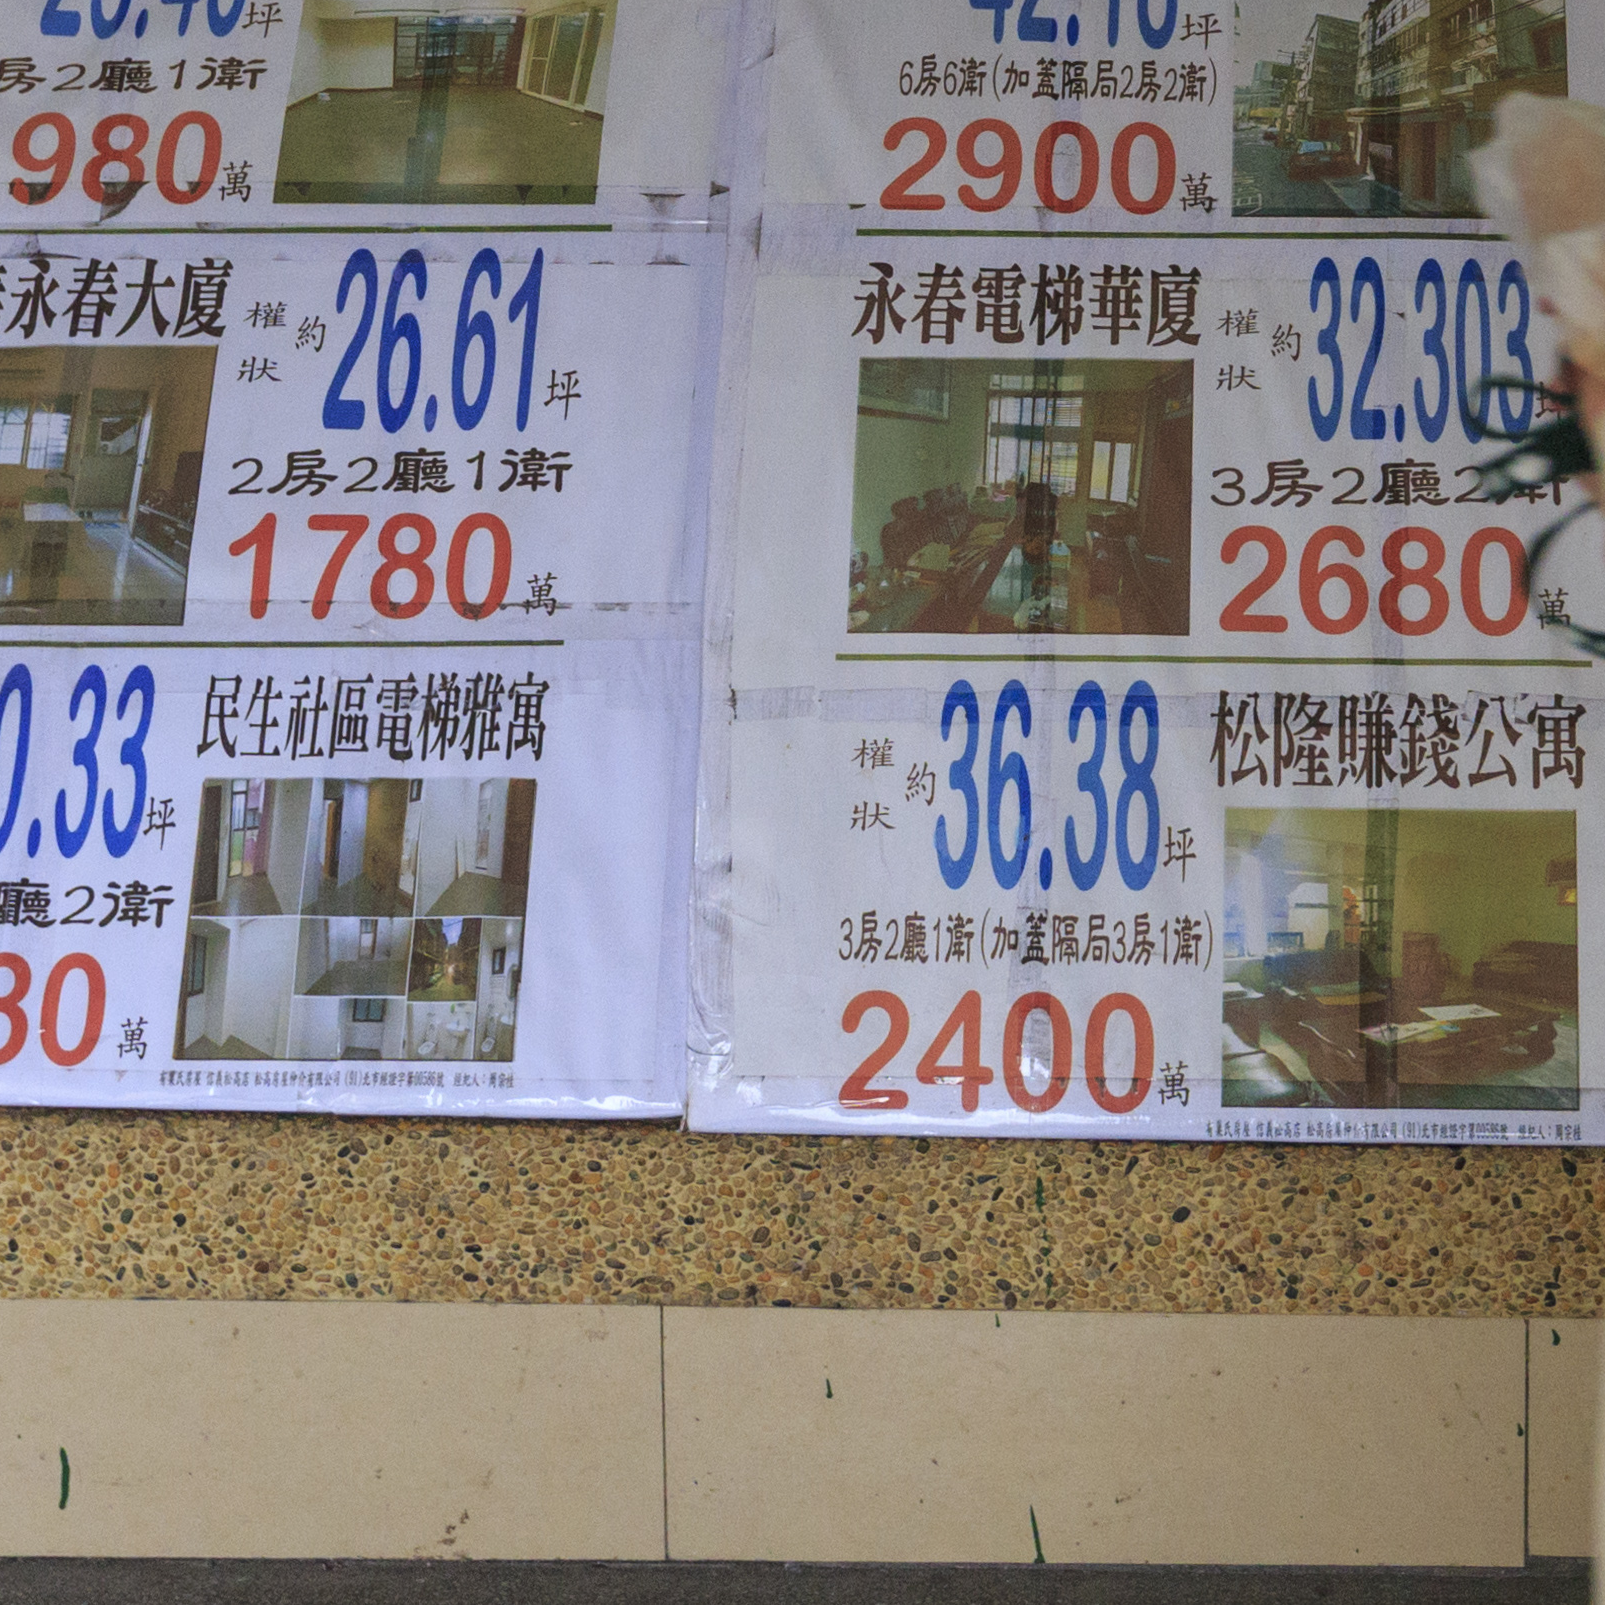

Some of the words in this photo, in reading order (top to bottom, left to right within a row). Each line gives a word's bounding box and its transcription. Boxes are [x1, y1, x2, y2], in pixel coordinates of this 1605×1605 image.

[244, 1, 283, 38] 坪
[1181, 13, 1223, 51] 坪
[217, 161, 253, 202] 萬
[879, 116, 1176, 216] 2900
[1179, 173, 1218, 214] 萬
[294, 316, 327, 354] 約
[322, 247, 545, 434] 26.61
[543, 369, 582, 421] 坪
[850, 261, 1202, 347] 永春電梯華廈
[1271, 322, 1302, 361] 約
[1307, 256, 1535, 445] 32.303
[227, 449, 572, 498] 2房2廳1衛
[227, 511, 513, 621] 1780
[525, 572, 558, 617] 萬
[1218, 524, 1529, 637] 2680
[196, 670, 550, 763] 民生社區電梯雅寓
[1210, 690, 1588, 791] 松隆賺錢公寓
[144, 797, 176, 850] 坪
[904, 760, 936, 807] 約
[934, 678, 1160, 892] 36.38
[1164, 827, 1197, 883] 坪
[117, 1016, 150, 1062] 萬
[839, 989, 1156, 1114] 2400
[1156, 1061, 1191, 1107] 萬
